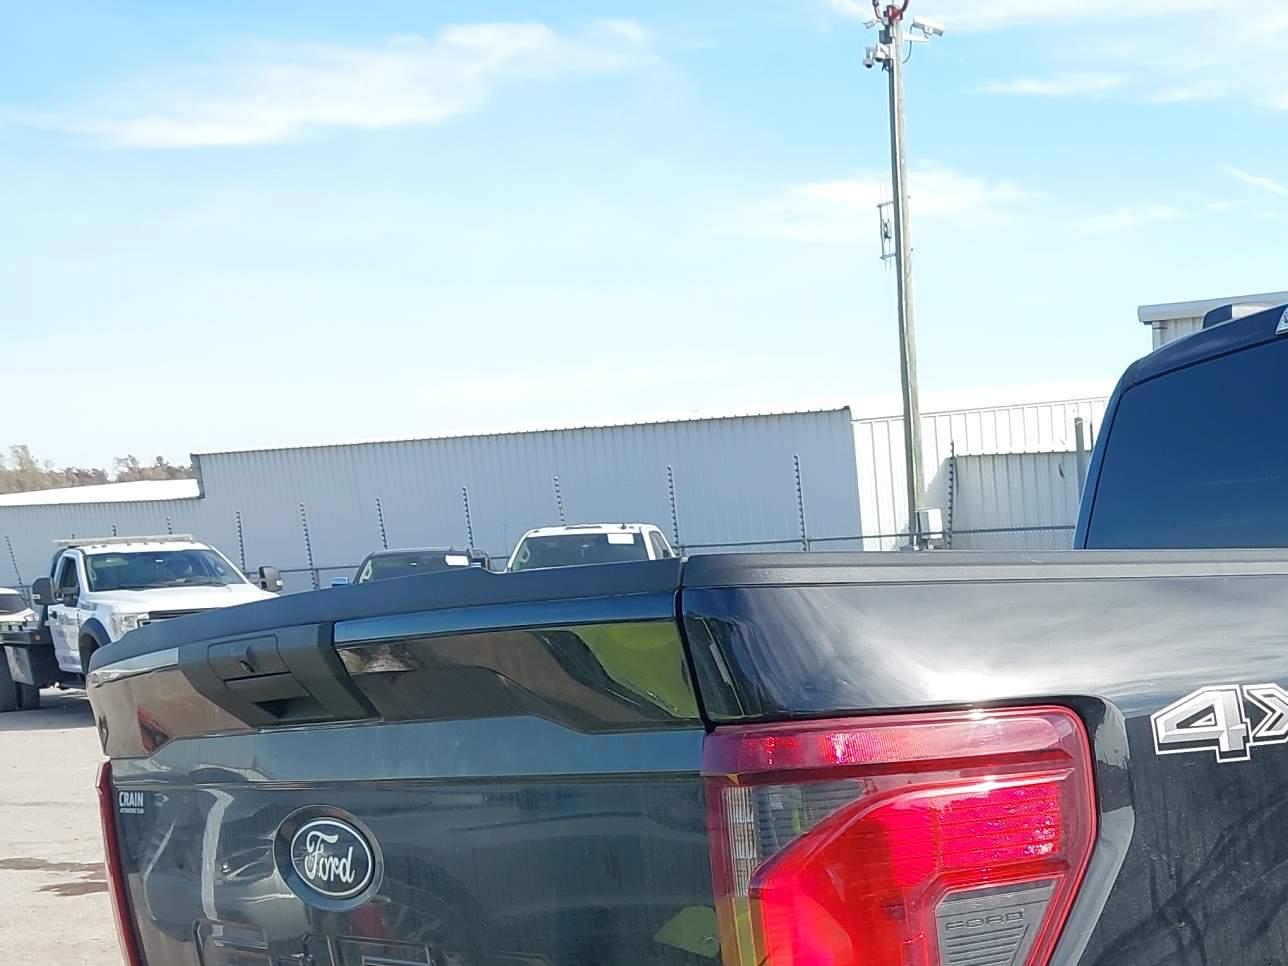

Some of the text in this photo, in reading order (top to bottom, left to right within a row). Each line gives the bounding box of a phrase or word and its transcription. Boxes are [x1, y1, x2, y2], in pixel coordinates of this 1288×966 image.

[118, 791, 145, 808] CRAIN
[304, 829, 356, 884] Ford
[945, 908, 1024, 931] FORD
